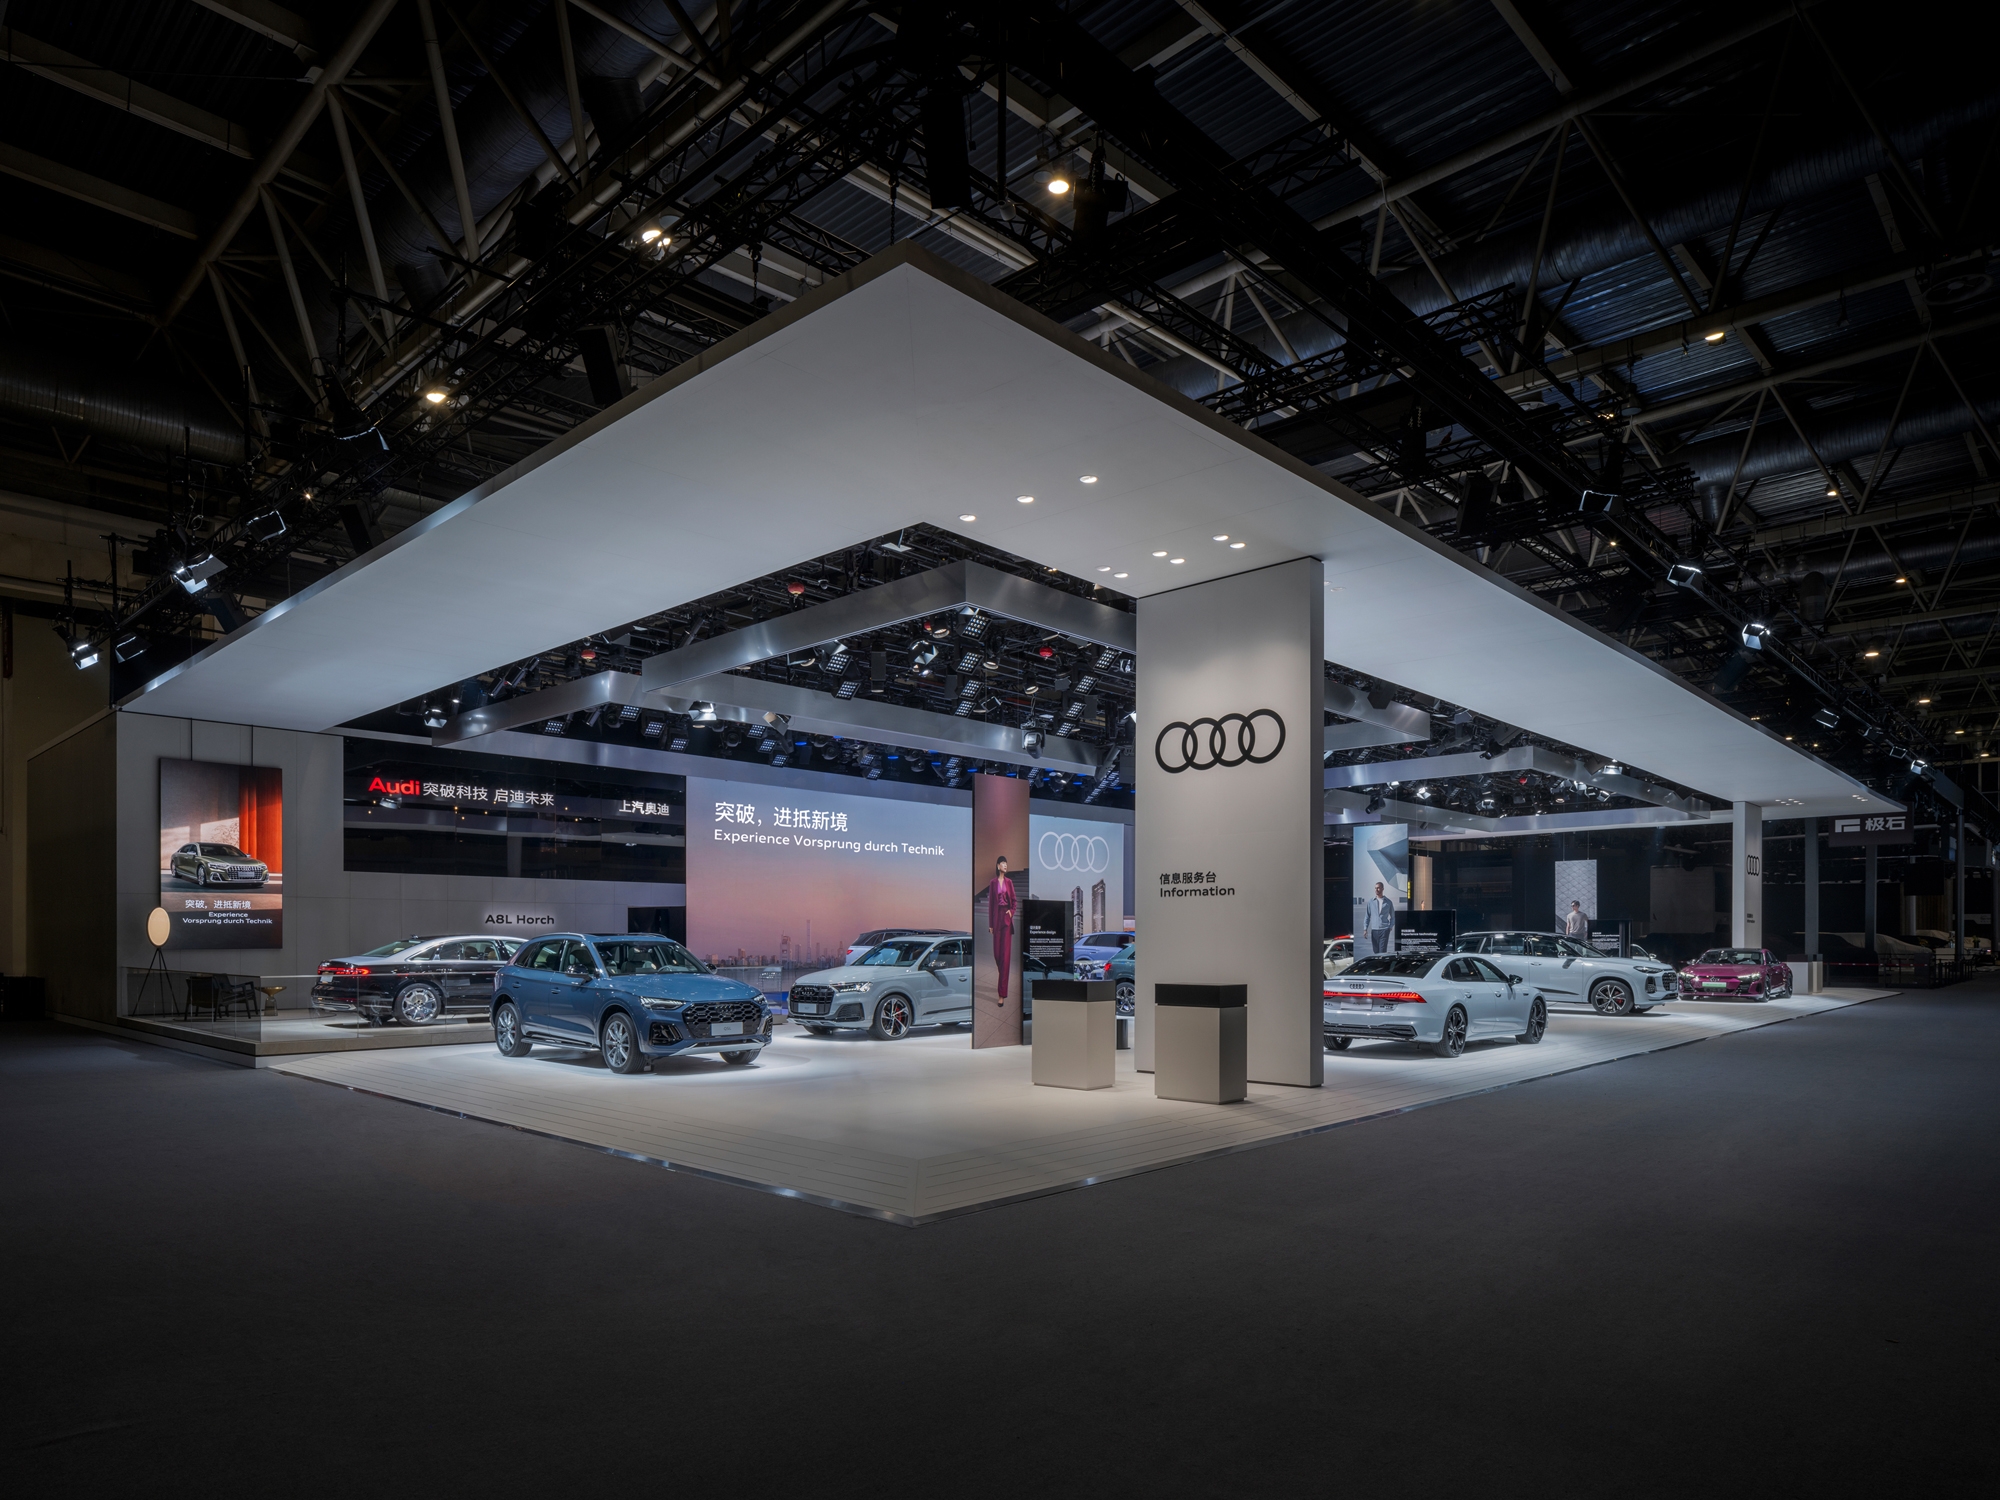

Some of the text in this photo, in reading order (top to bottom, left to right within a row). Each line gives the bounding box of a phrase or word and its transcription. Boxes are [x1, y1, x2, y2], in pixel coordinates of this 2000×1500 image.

[368, 777, 421, 796] Audi
[423, 782, 555, 806] 突破科技 启迪未来
[619, 799, 670, 816] 上汽奥迪
[715, 801, 848, 832] 突破，进抵新境
[1865, 816, 1907, 832] 极石
[714, 829, 945, 856] Experience Vorsprung durch Technik
[1159, 871, 1217, 885] 信息服务台
[1160, 886, 1235, 898] Information
[182, 917, 222, 925] Vorsprung
[208, 911, 249, 919] Experience
[485, 914, 555, 925] A8L Horch
